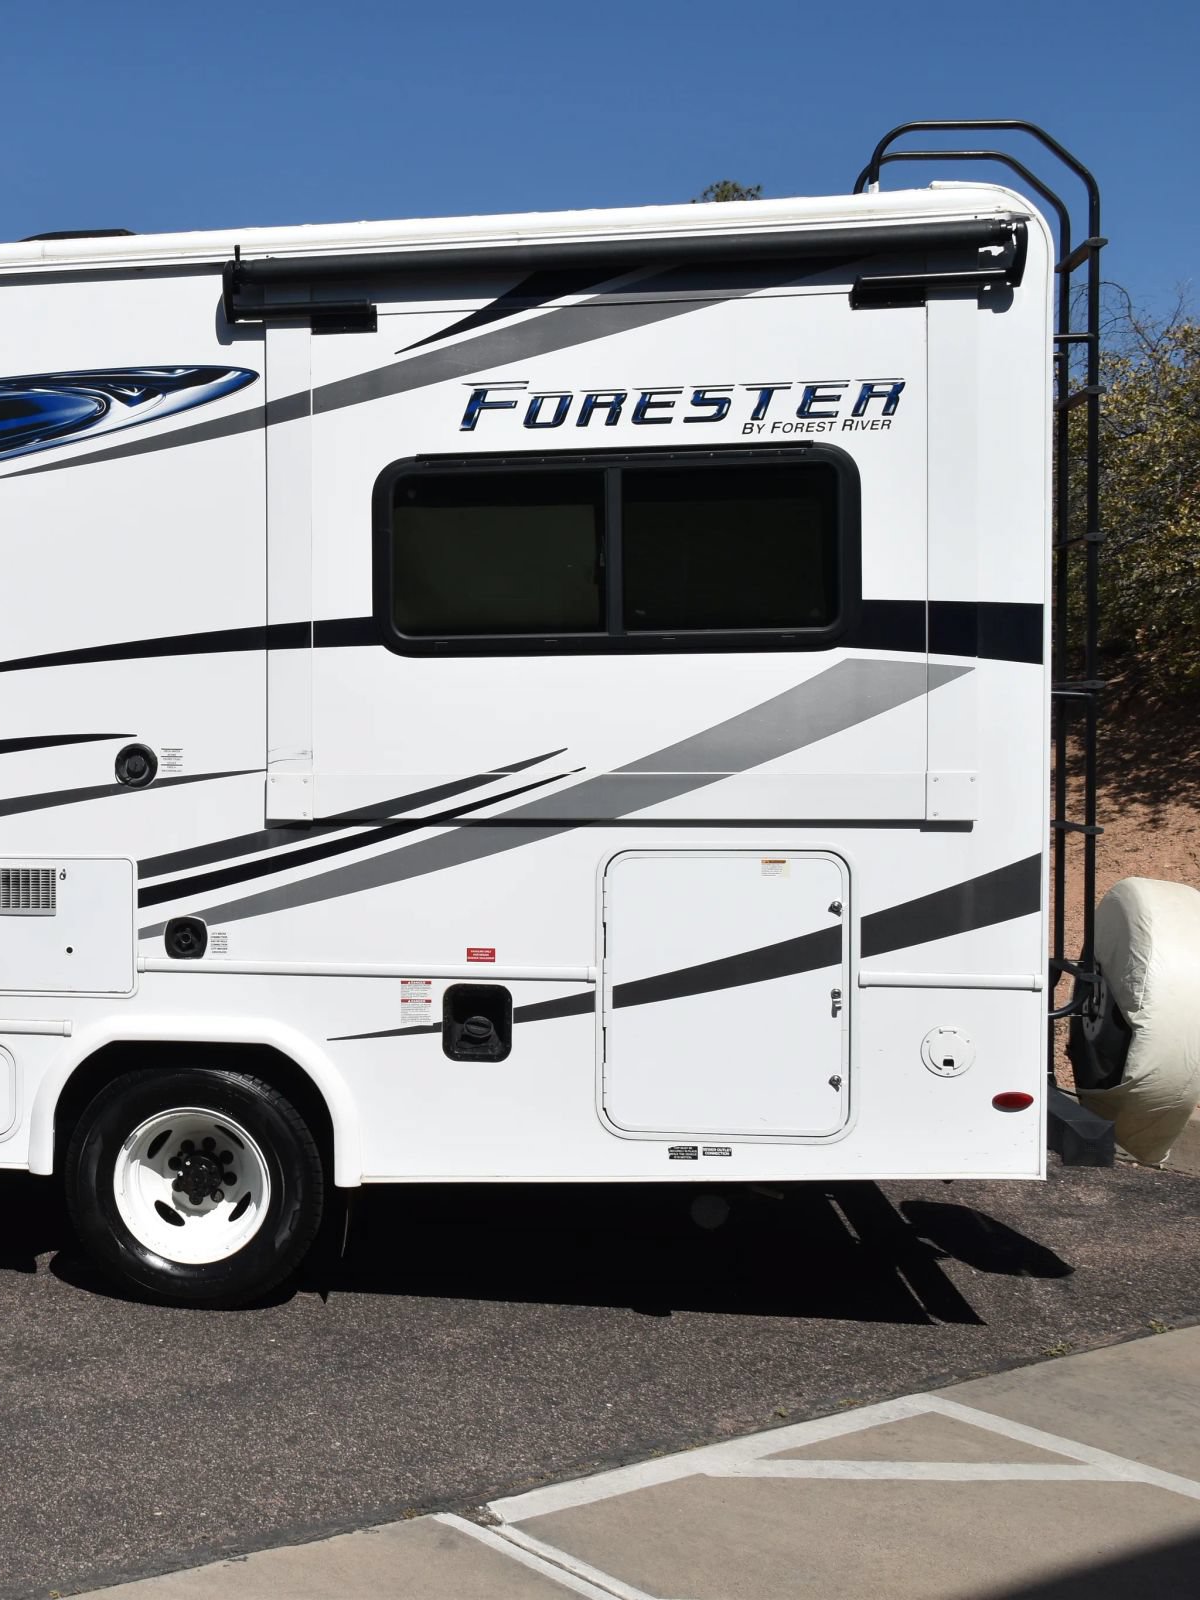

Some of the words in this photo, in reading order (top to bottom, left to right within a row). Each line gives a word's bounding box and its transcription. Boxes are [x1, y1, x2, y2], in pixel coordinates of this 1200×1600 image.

[459, 378, 906, 431] FORESTER
[741, 422, 766, 435] BY
[770, 421, 837, 433] FOREST
[841, 419, 892, 432] RIVER
